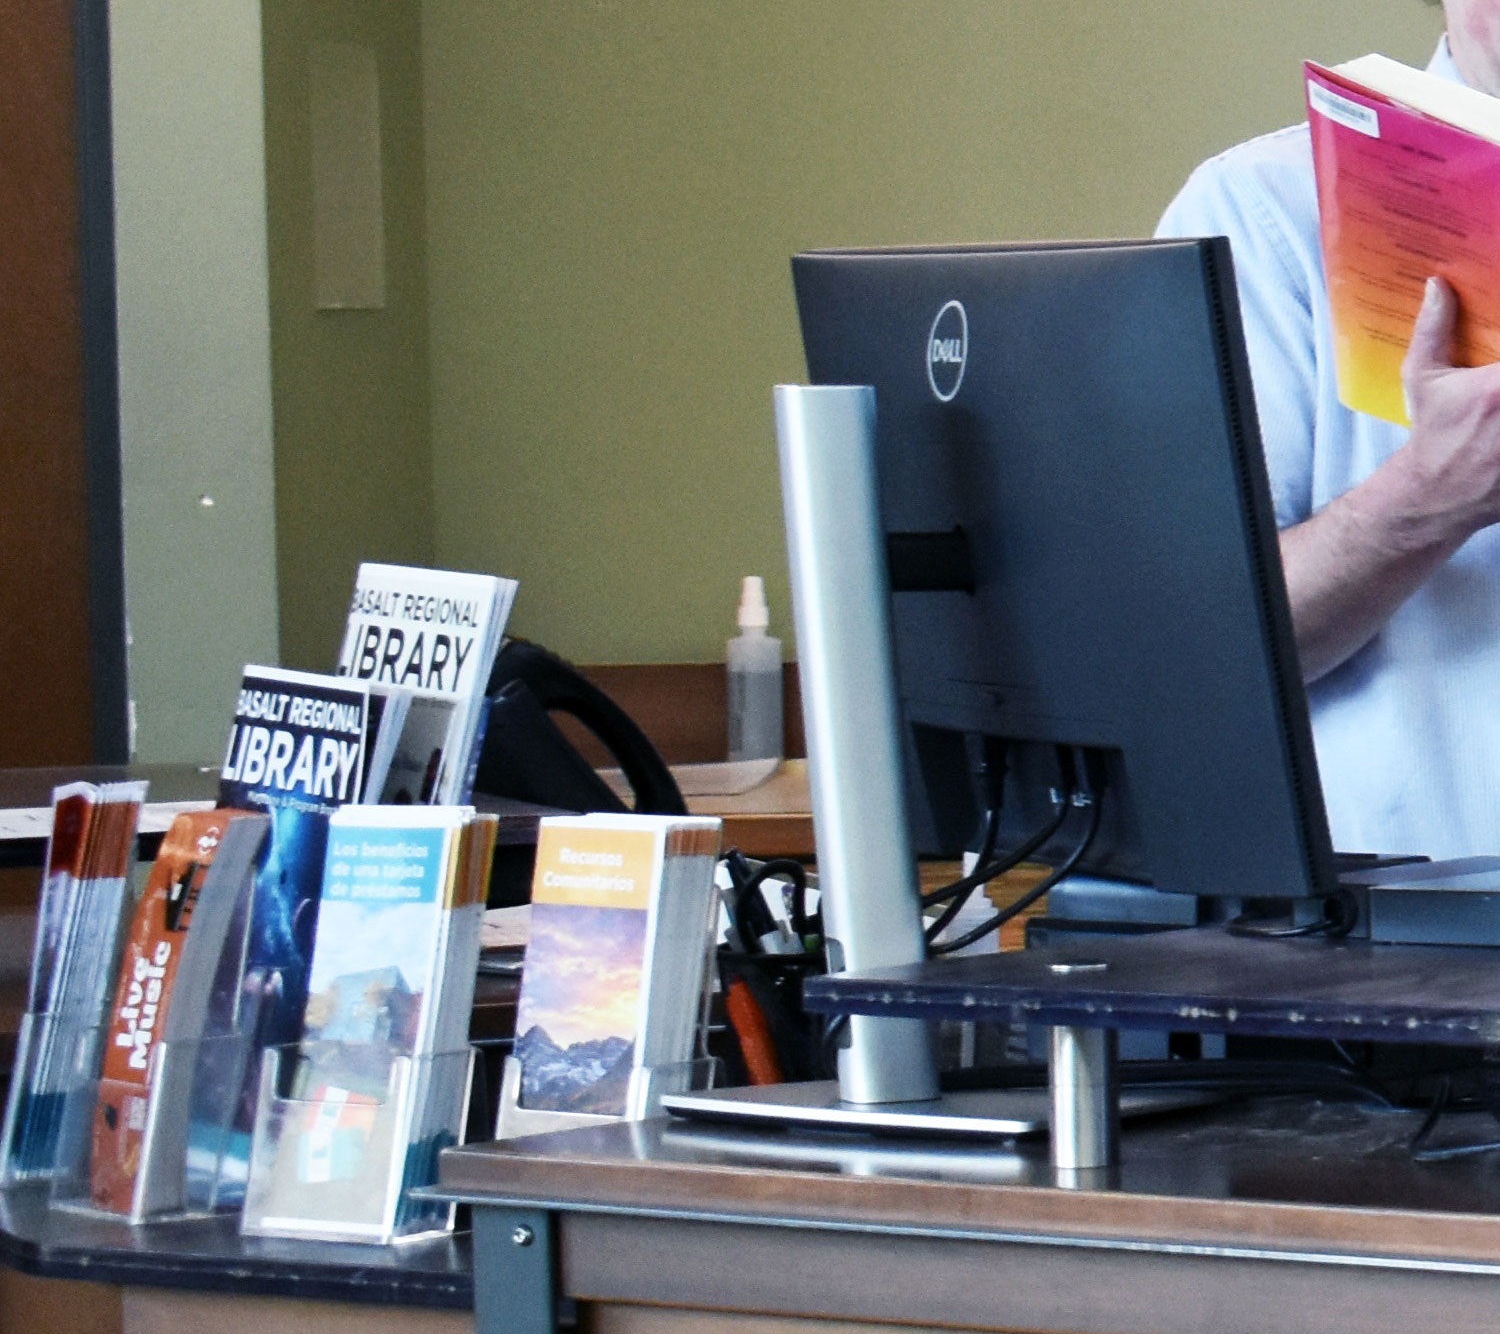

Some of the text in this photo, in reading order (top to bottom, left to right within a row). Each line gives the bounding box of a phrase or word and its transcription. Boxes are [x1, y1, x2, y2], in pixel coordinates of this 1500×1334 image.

[933, 338, 962, 363] DELL
[403, 593, 479, 629] REGIONAL
[237, 688, 361, 735] BASALT REGIONAL
[221, 723, 359, 801] LIBRARY
[115, 956, 150, 1048] Live
[127, 940, 172, 1070] Music
